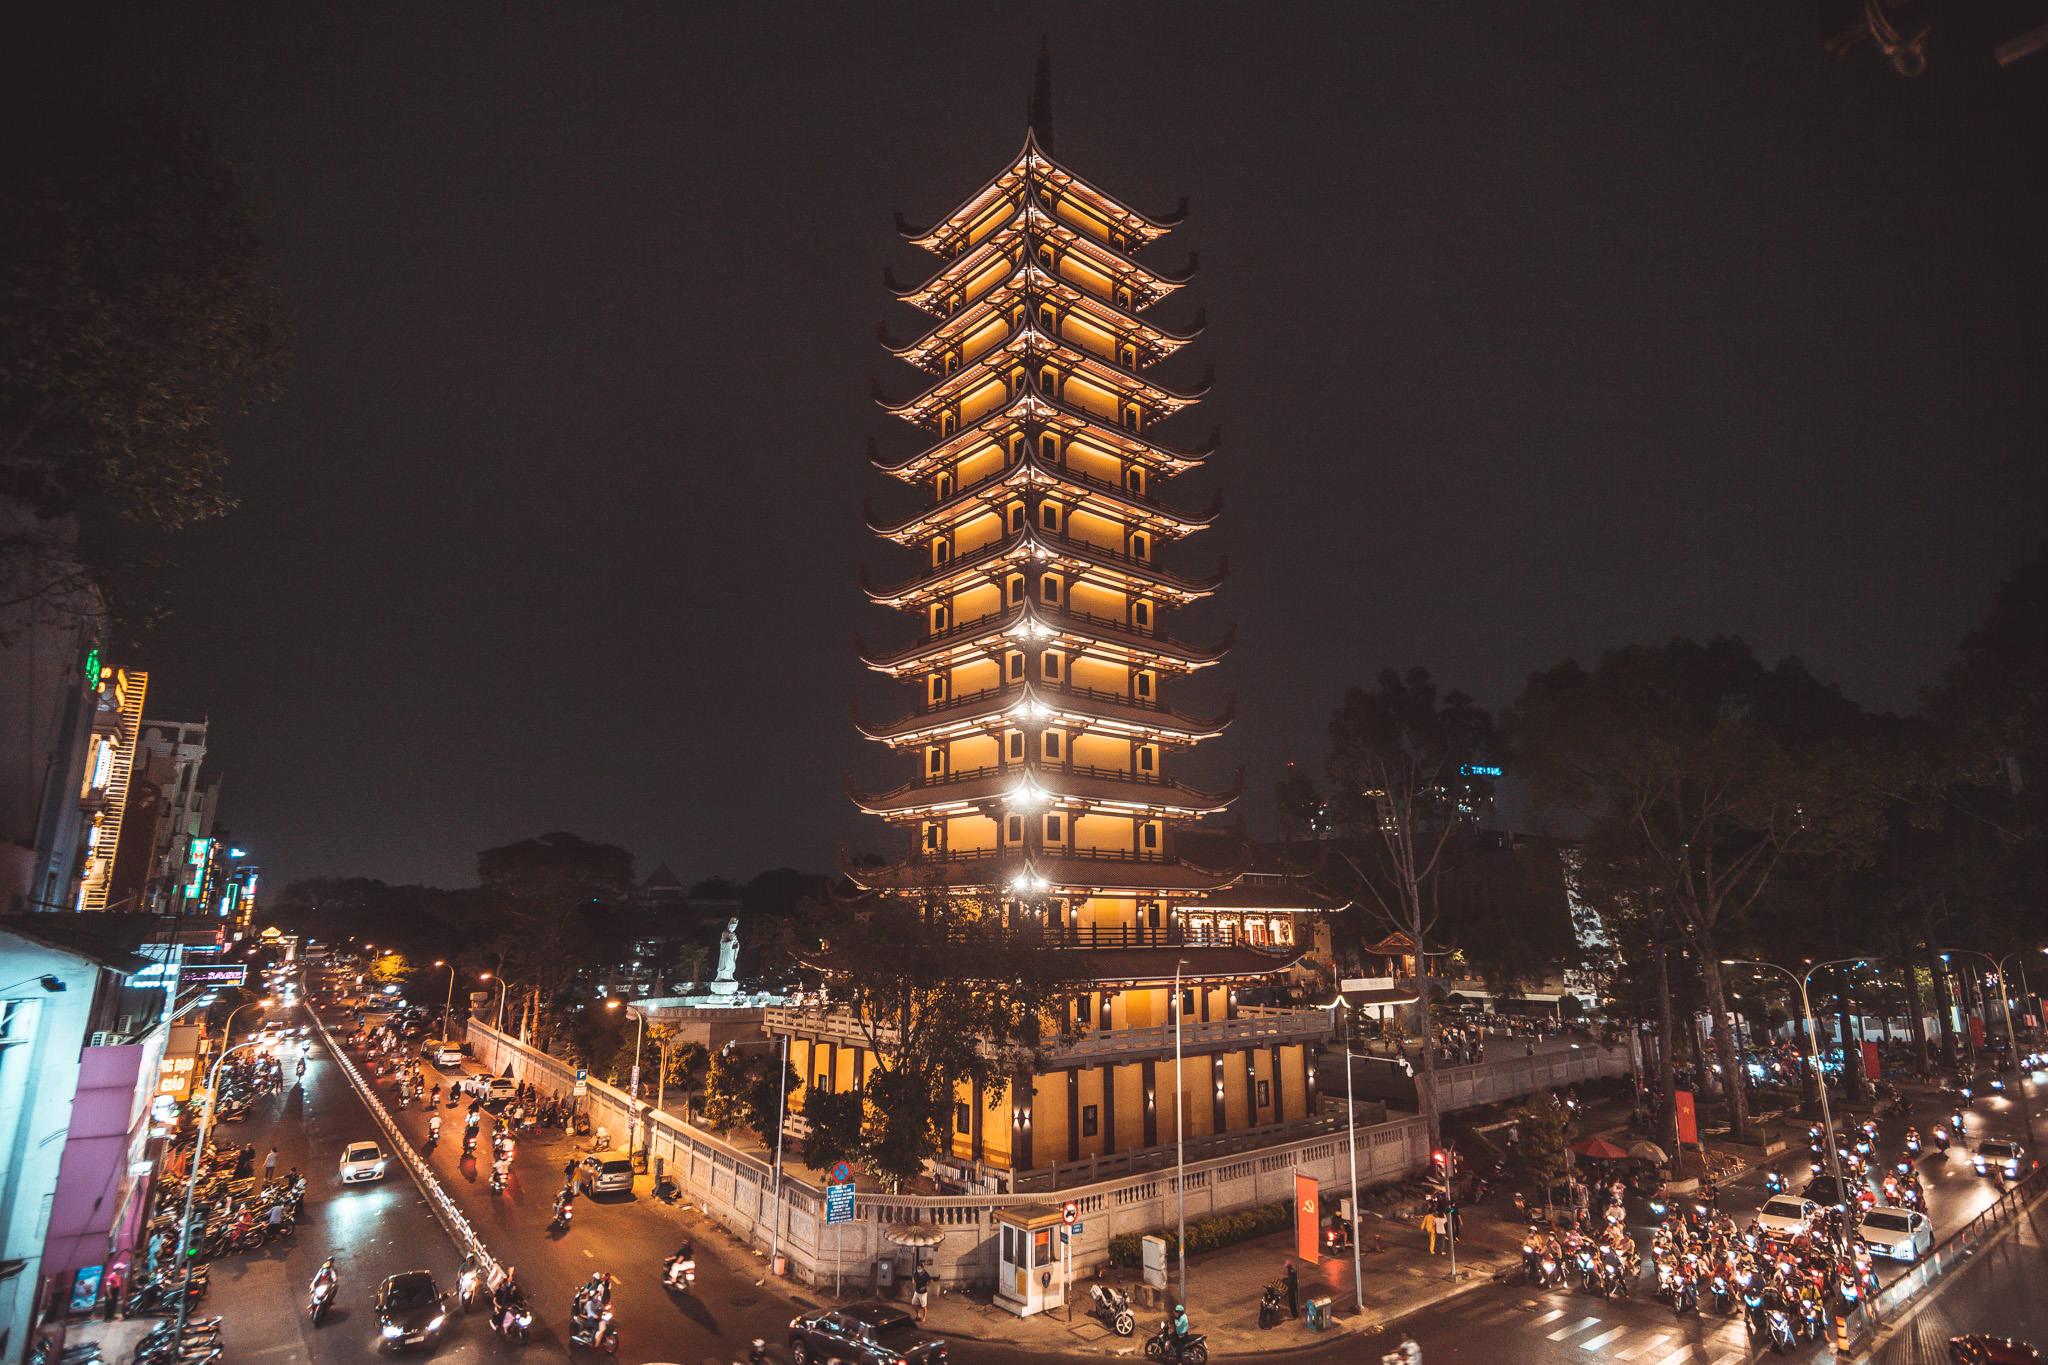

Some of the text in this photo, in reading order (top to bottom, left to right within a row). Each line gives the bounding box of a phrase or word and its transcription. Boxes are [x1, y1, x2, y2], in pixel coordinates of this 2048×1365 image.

[243, 899, 254, 926] HOTEL
[182, 970, 243, 981] SAGE
[161, 1075, 185, 1092] GIÁO
